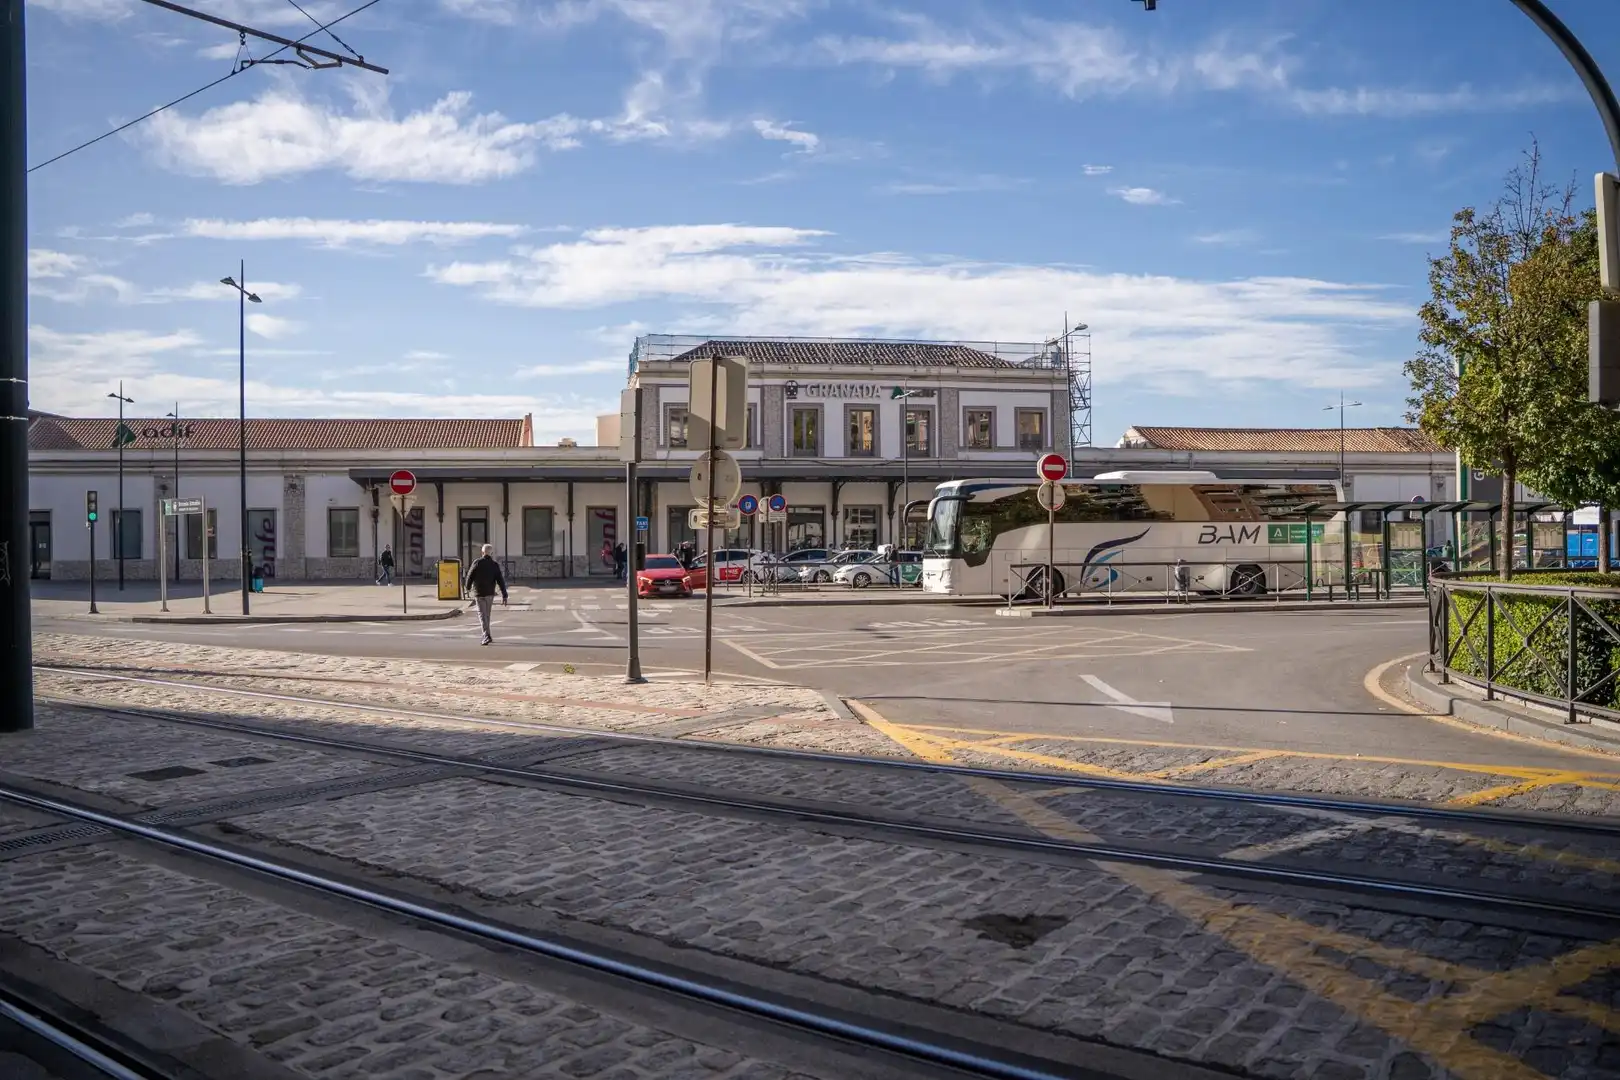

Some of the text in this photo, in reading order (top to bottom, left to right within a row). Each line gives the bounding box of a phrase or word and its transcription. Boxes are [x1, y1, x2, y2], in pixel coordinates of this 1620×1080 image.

[805, 383, 882, 399] GRANADA
[142, 423, 195, 438] adif
[1197, 525, 1261, 544] BAM
